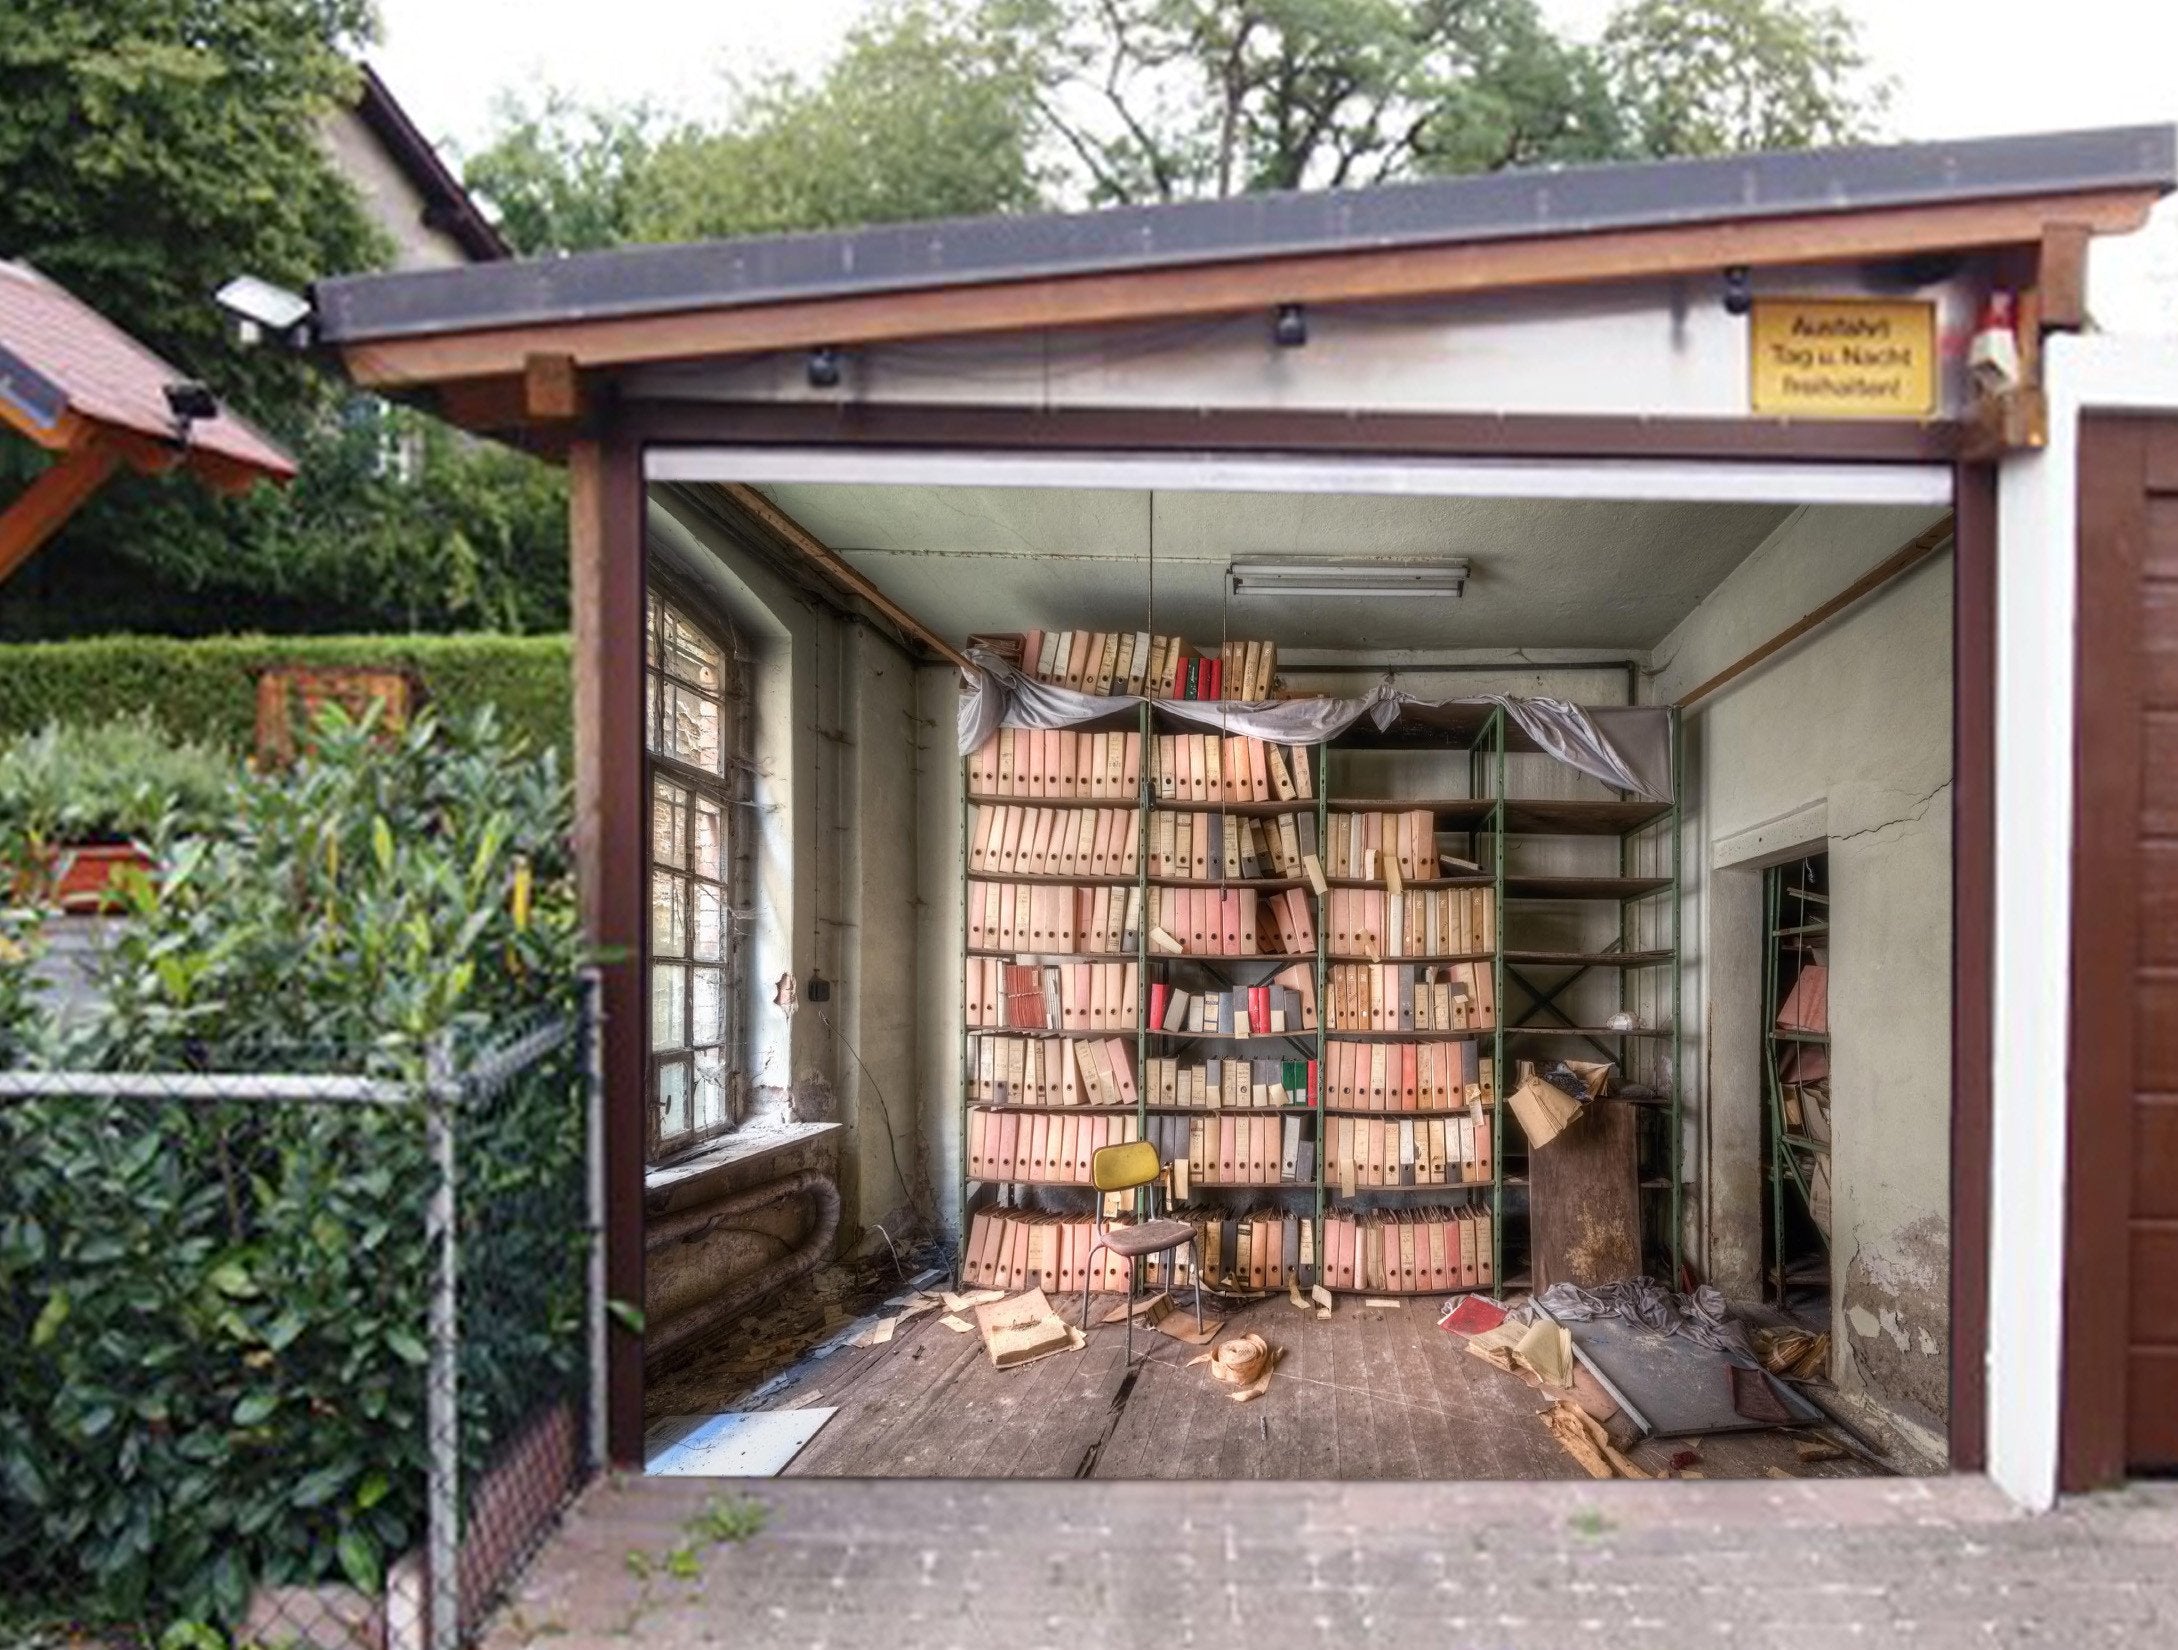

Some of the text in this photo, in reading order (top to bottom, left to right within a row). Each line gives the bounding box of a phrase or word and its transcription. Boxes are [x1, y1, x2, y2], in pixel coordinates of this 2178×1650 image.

[1792, 316, 1891, 338] Ausfahrt
[1771, 344, 1814, 368] Tag
[1842, 346, 1912, 366] Nacht
